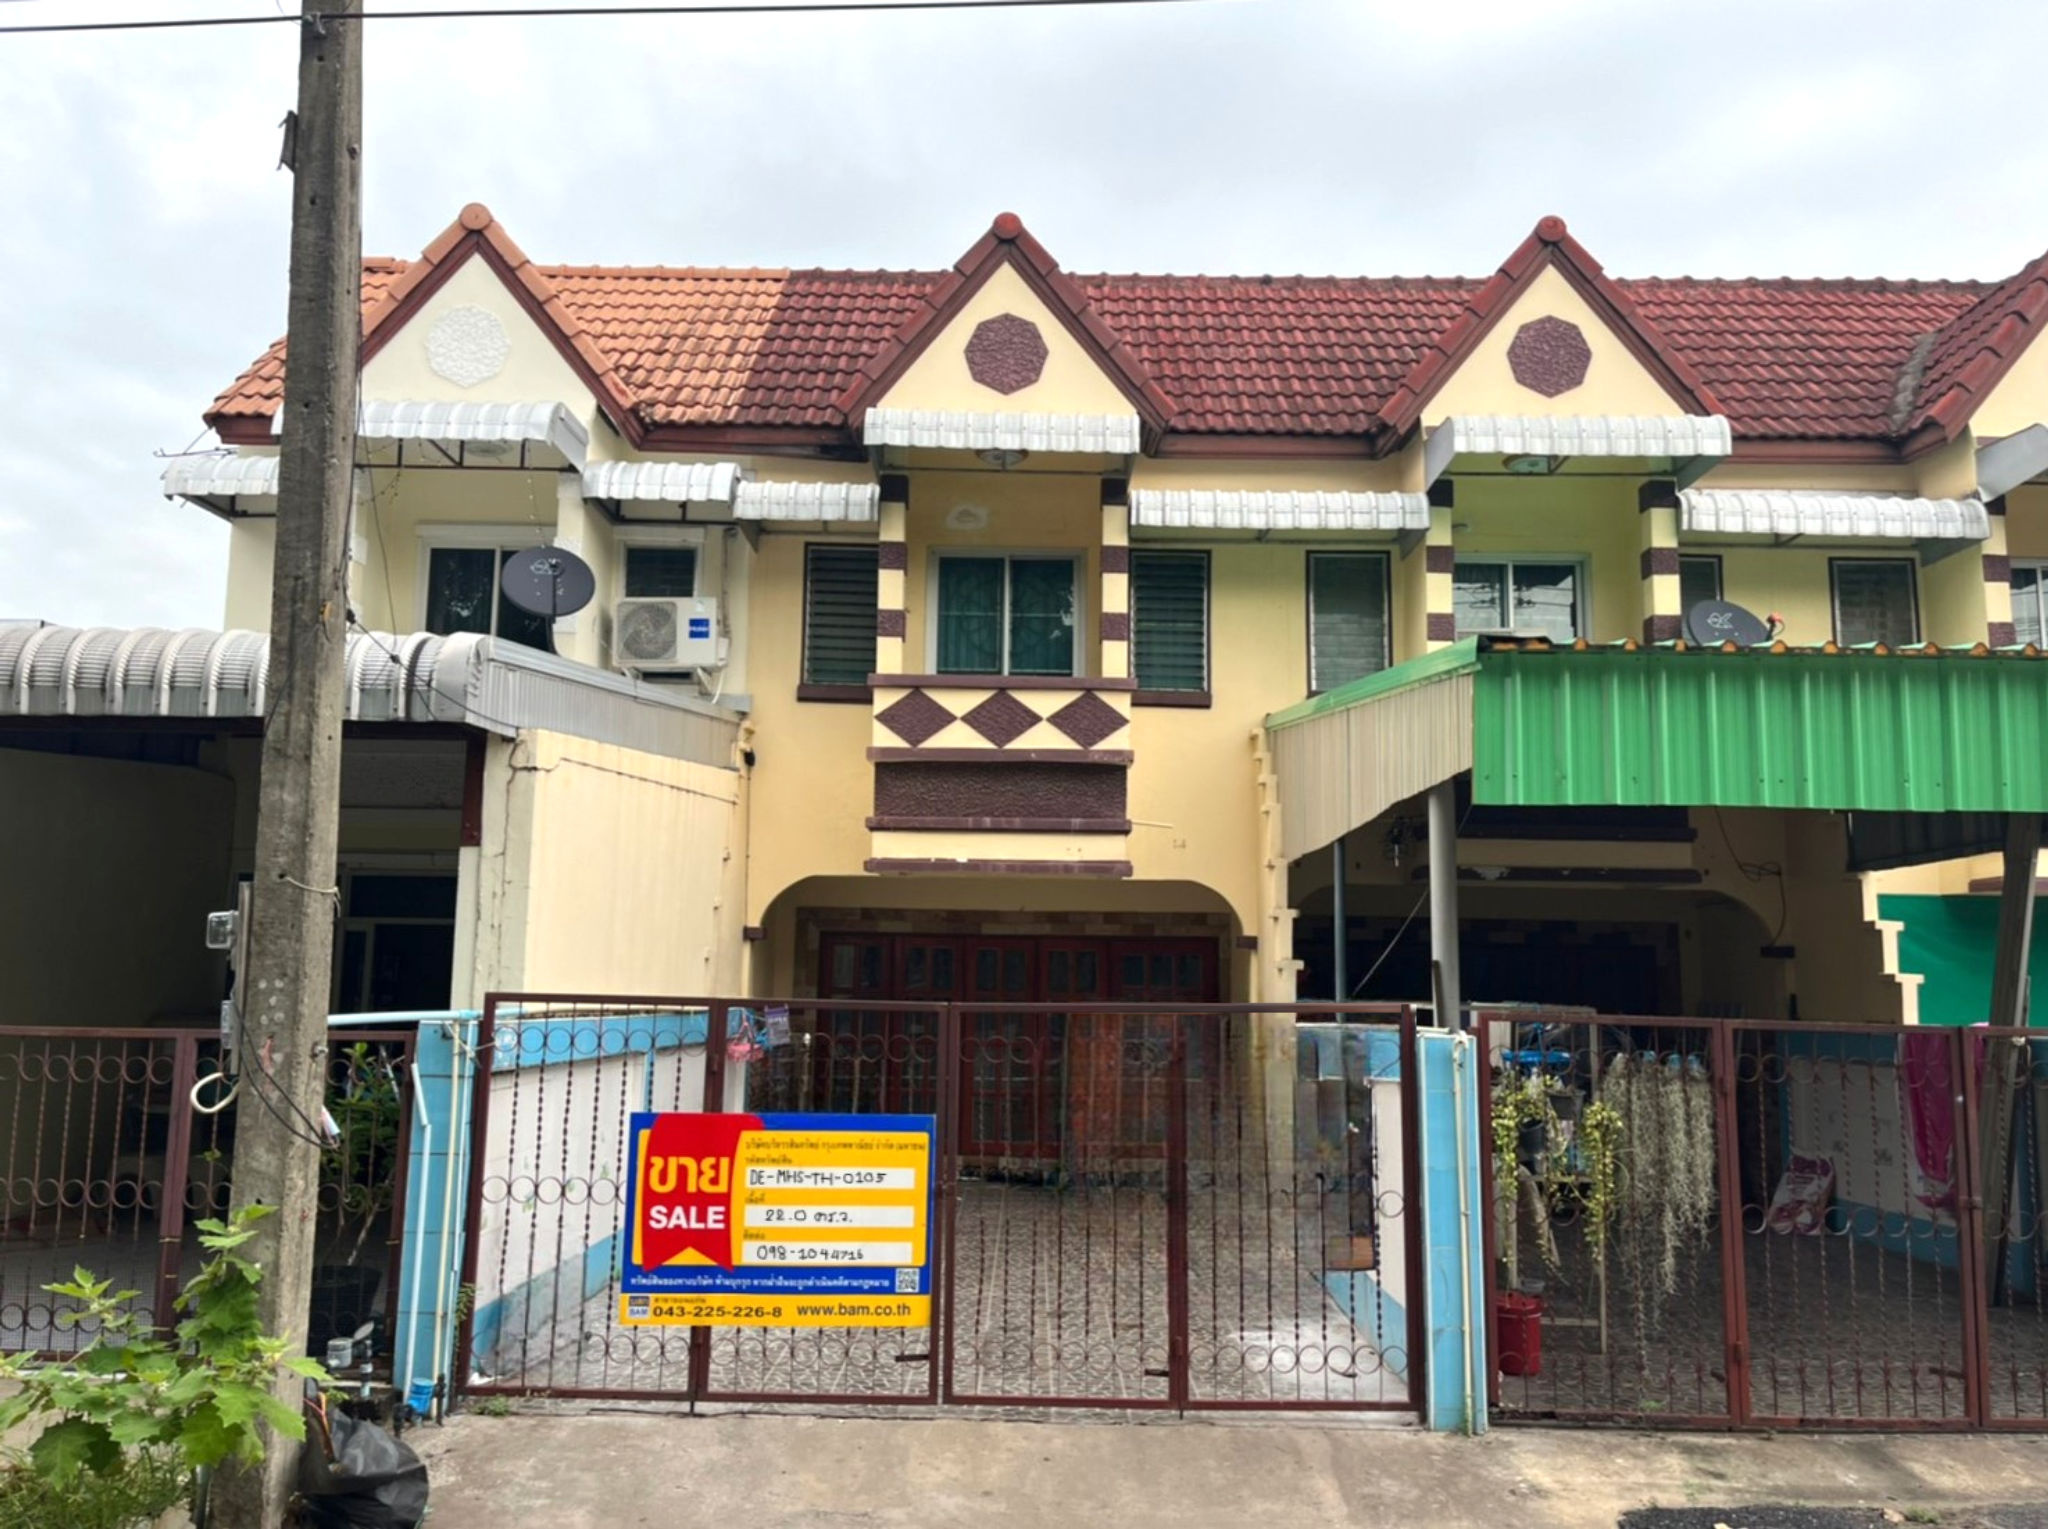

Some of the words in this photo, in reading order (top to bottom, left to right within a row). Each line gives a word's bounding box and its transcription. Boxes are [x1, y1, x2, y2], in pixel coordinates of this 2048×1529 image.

[649, 1155, 730, 1194] ขาย
[648, 1205, 726, 1229] SALE
[652, 1306, 782, 1318] 043-225-226-8
[796, 1302, 911, 1317] www.bam.co.th
